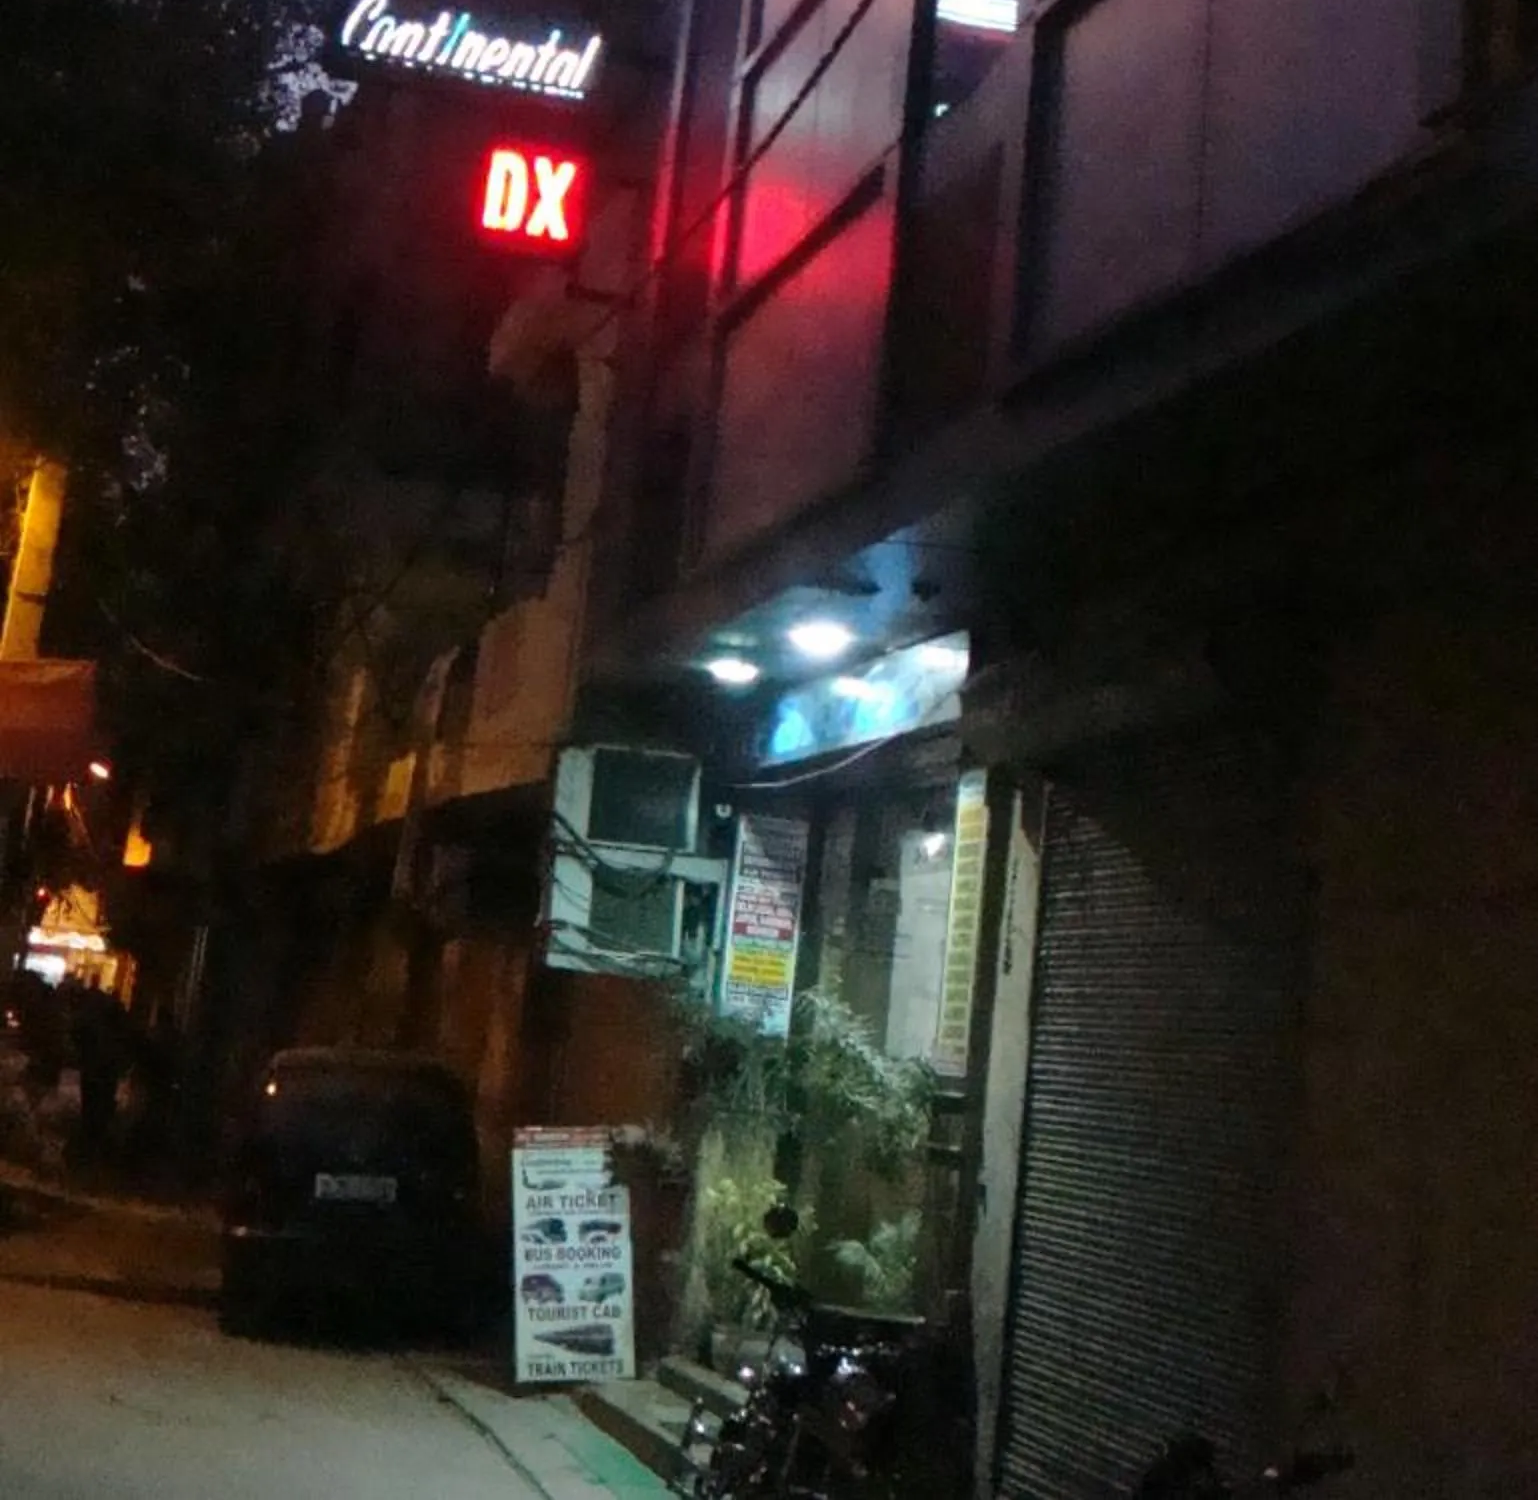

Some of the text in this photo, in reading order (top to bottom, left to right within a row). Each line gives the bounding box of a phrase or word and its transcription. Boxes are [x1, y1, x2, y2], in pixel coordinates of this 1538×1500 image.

[482, 148, 577, 241] DX
[526, 1193, 619, 1209] AIR TICKET
[525, 1245, 623, 1262] BUS BOOKING
[528, 1304, 622, 1321] TOURIST CAB
[527, 1359, 625, 1377] TRAIN TICKETS
